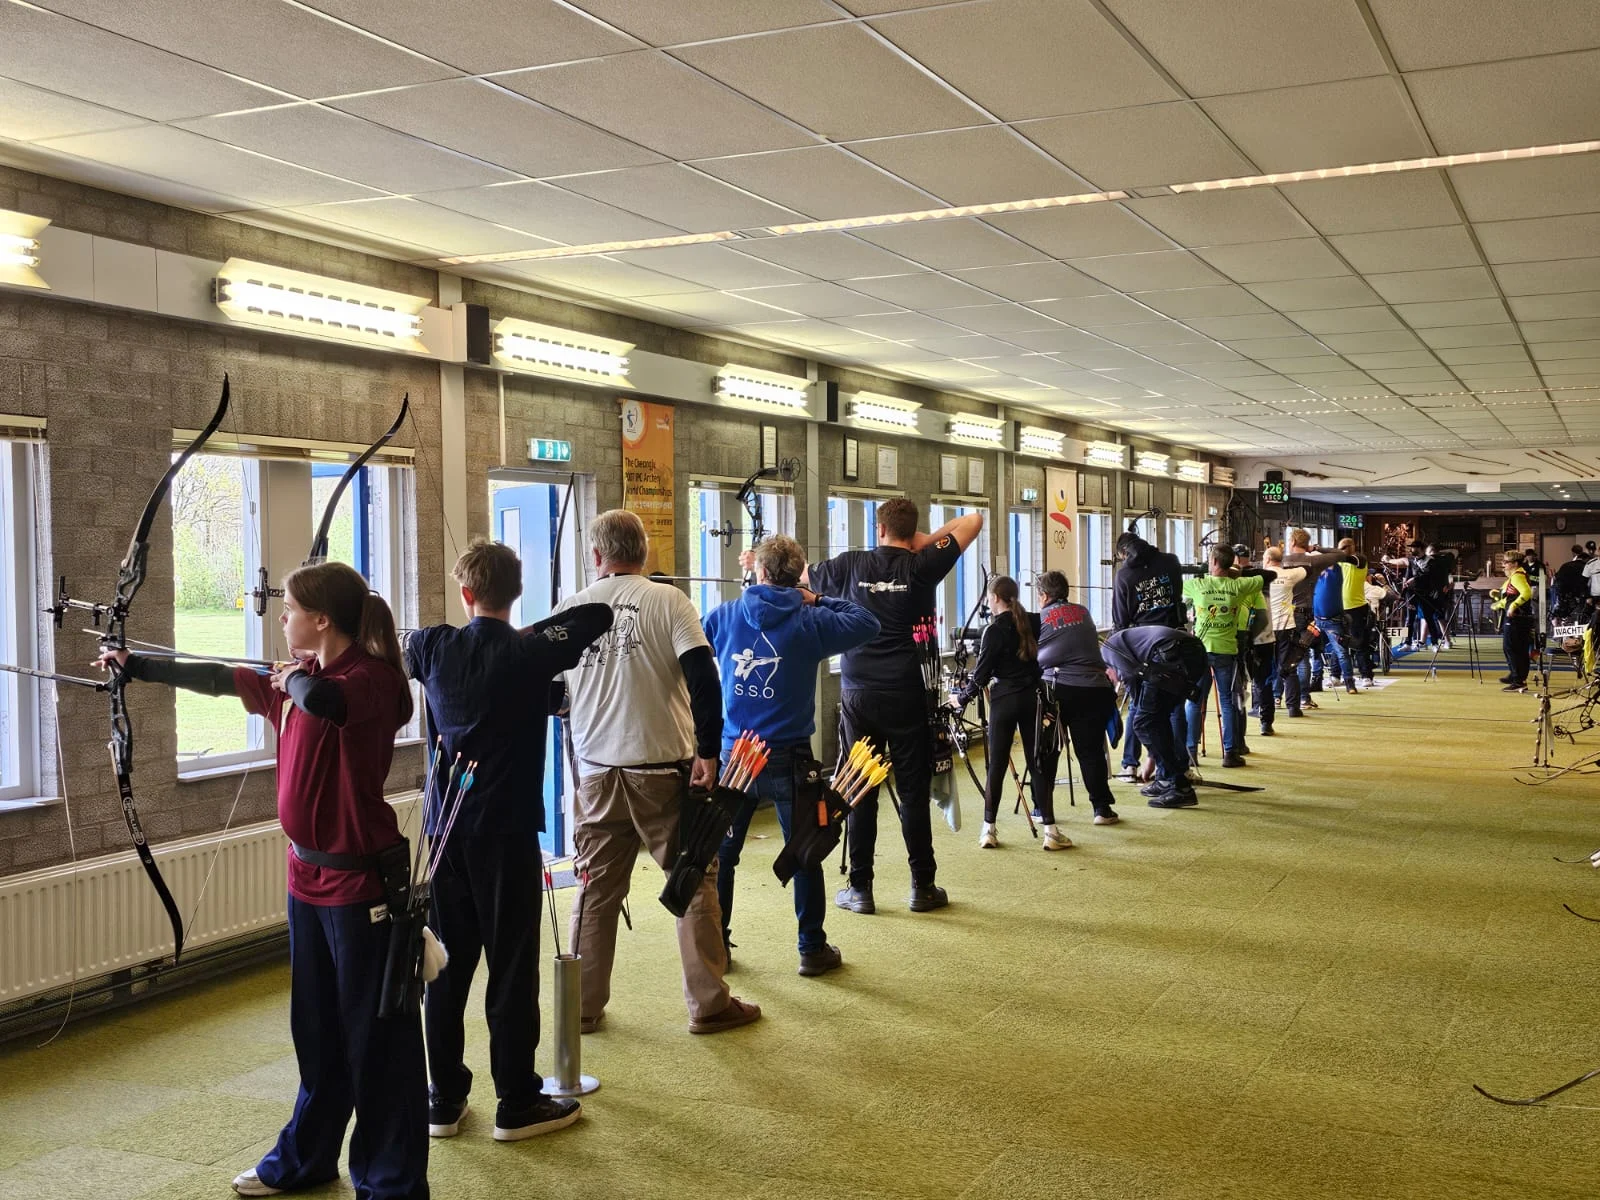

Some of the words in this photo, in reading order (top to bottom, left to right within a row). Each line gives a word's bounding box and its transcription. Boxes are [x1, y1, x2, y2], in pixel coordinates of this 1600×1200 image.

[1262, 483, 1283, 495] 226
[1339, 515, 1357, 524] 226
[1047, 605, 1084, 629] PSE
